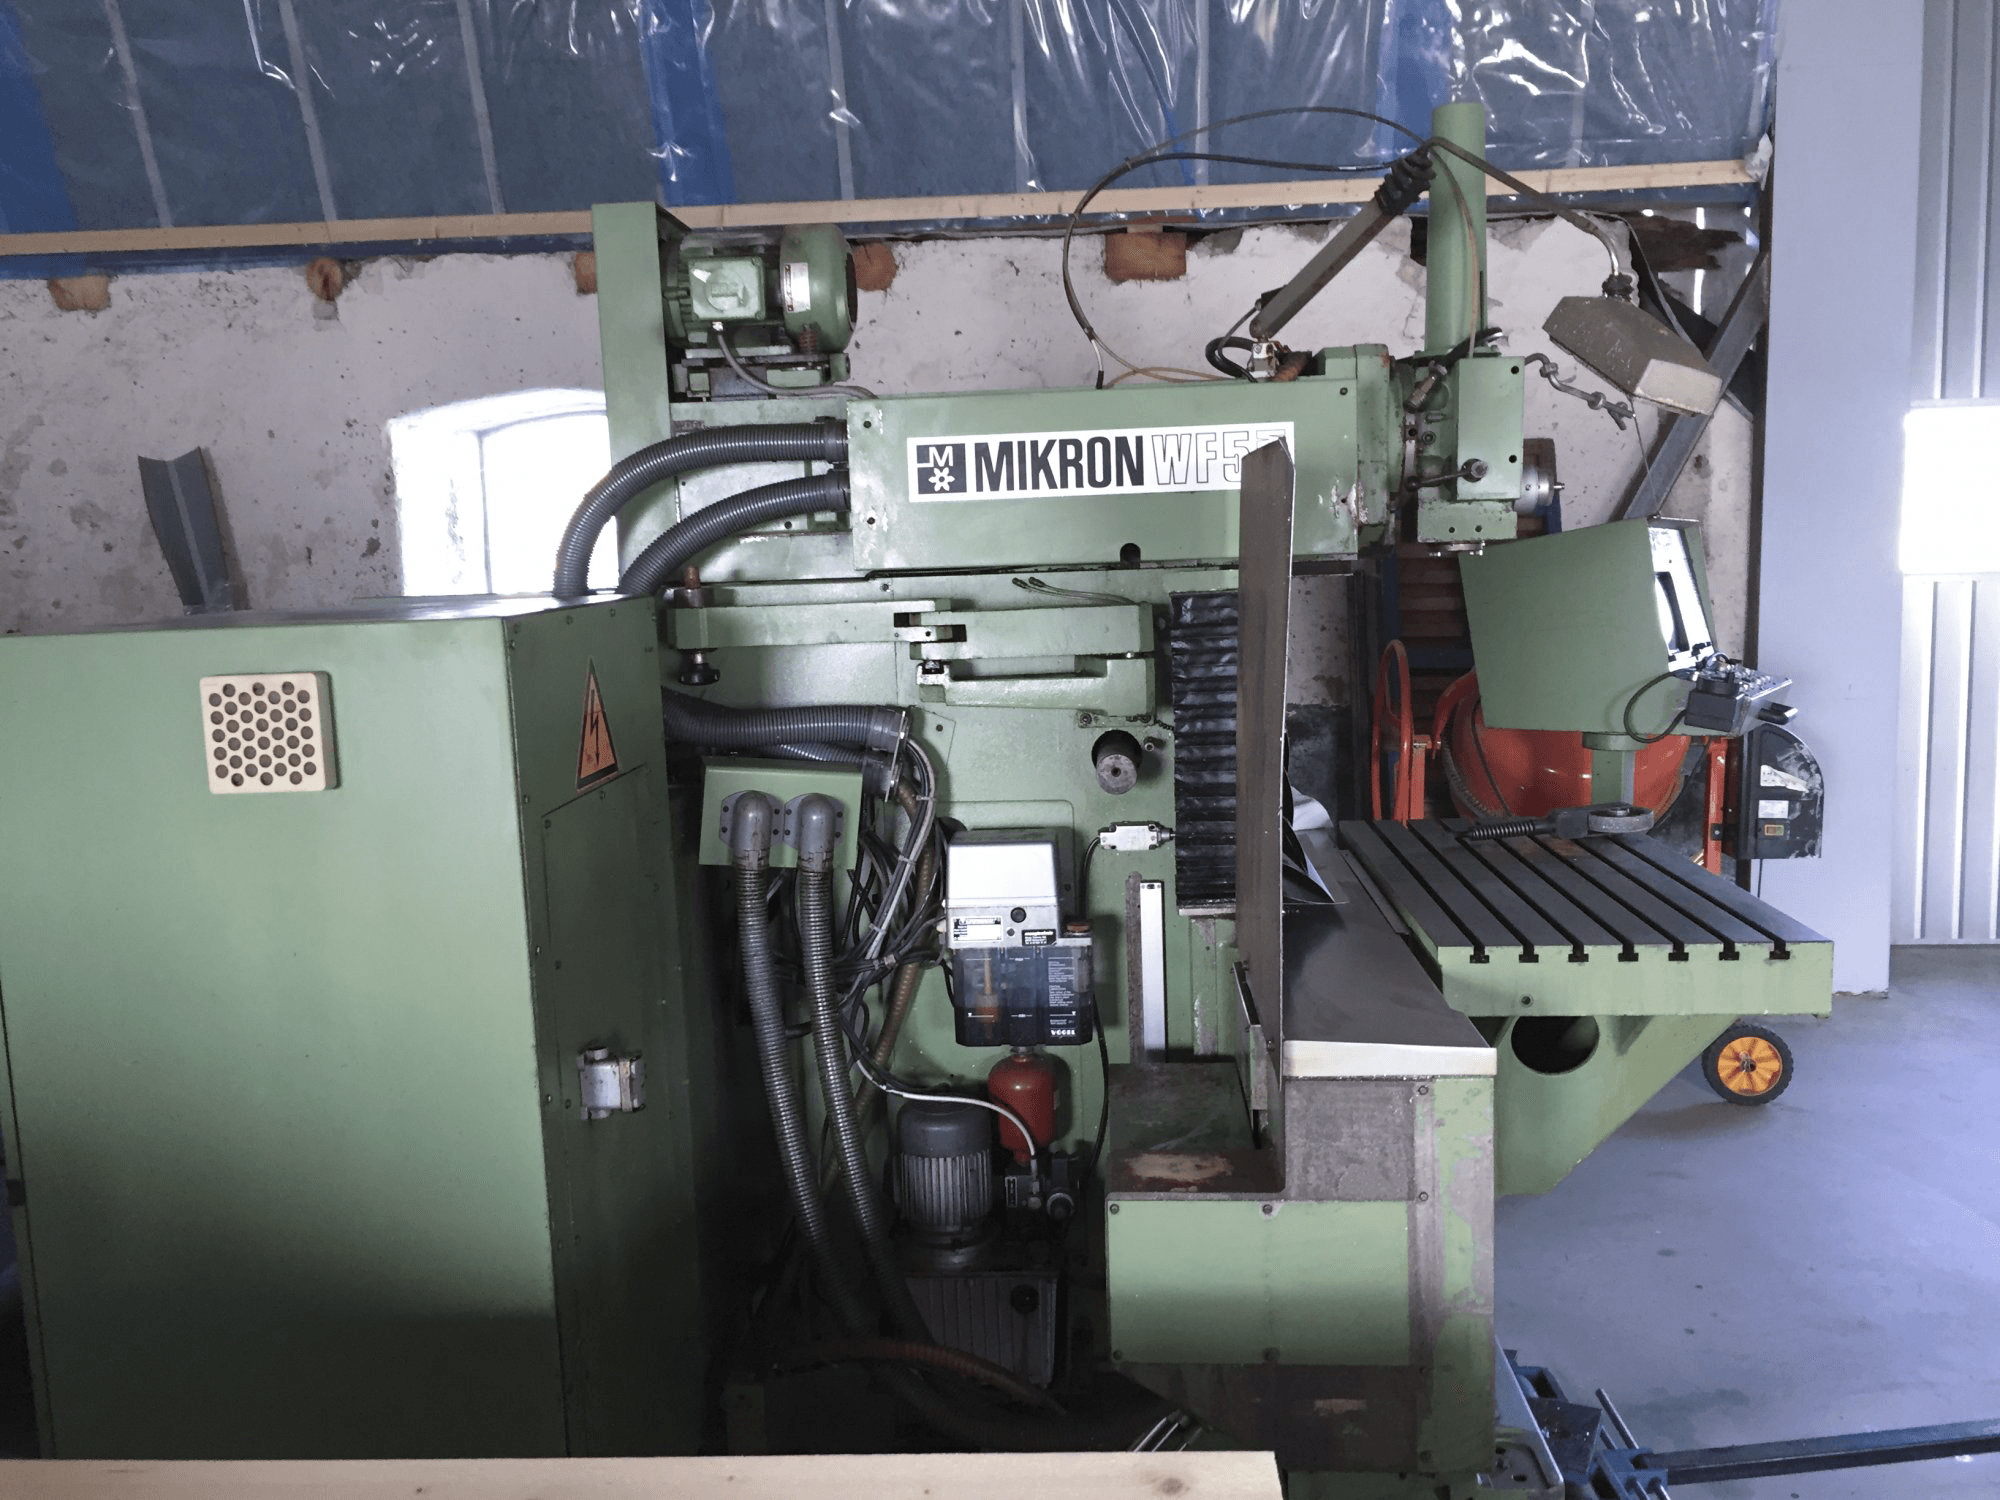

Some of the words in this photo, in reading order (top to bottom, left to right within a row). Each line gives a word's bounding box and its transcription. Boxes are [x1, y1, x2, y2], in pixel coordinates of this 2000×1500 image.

[928, 445, 954, 468] M
[974, 435, 1145, 492] MIKRON
[1151, 429, 1286, 486] WF5
